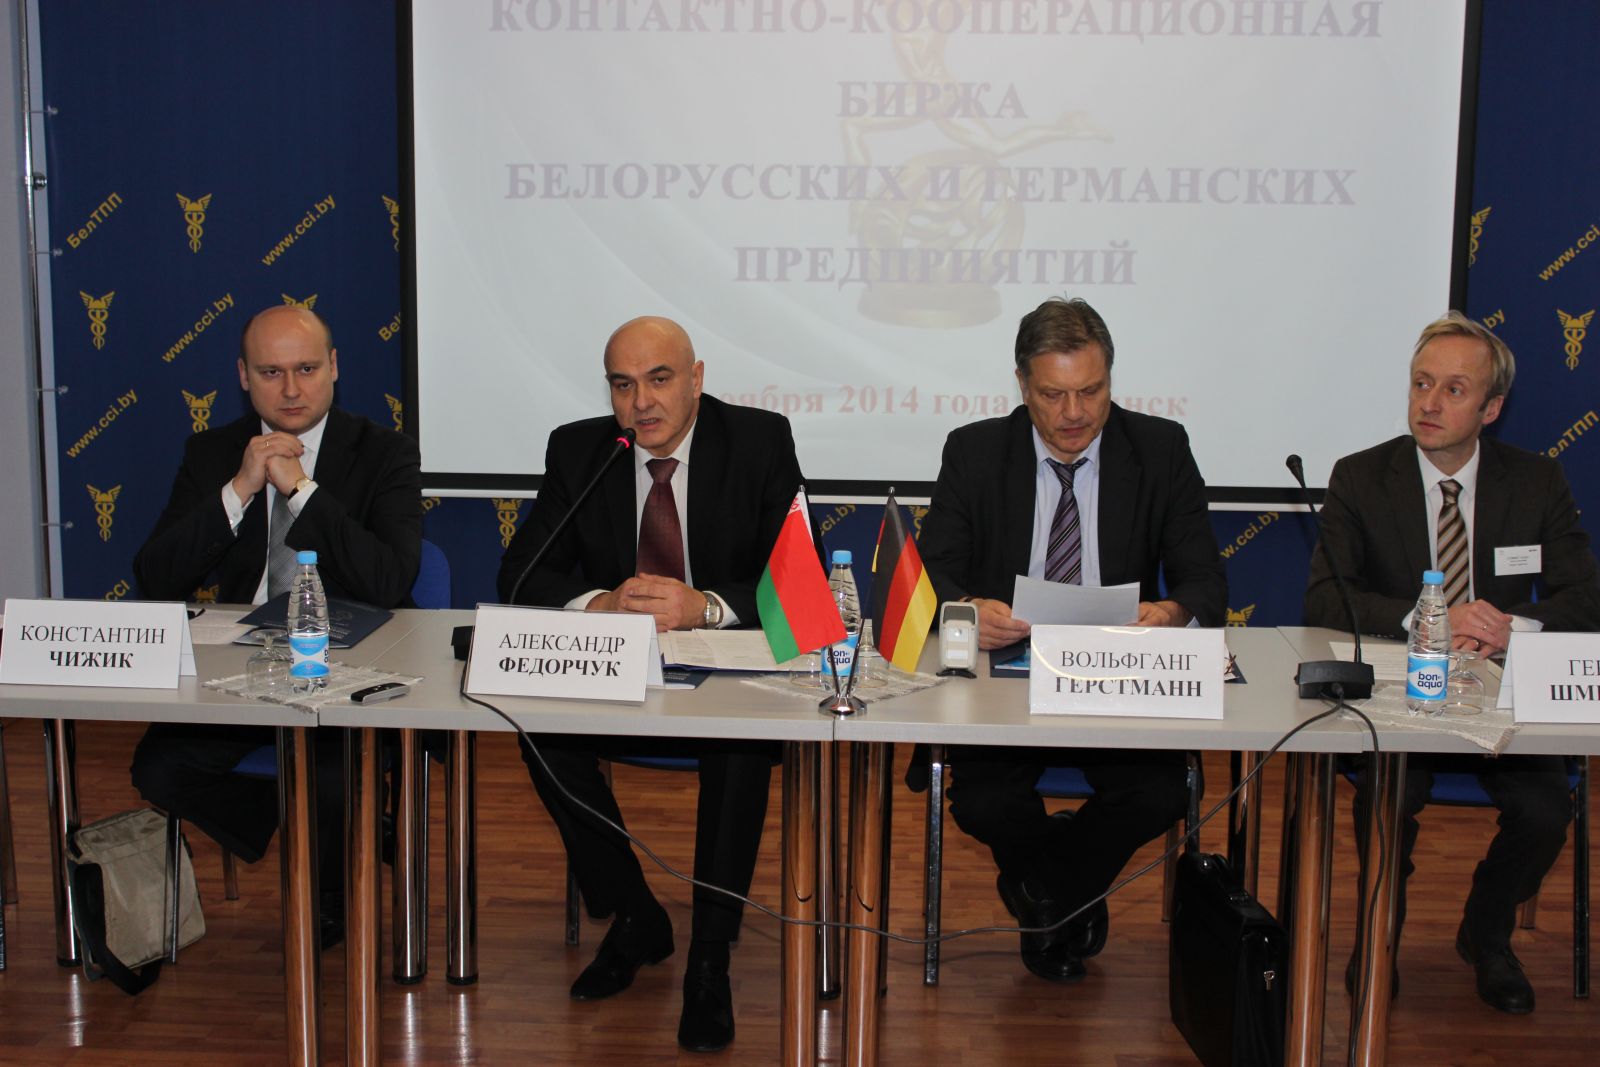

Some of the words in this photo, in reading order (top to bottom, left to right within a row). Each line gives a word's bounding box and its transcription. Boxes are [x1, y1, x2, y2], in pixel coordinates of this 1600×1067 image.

[489, 0, 1383, 43] КОНТАКТНО-КООПЕРАЦИОННАЯ
[836, 81, 1028, 119] БИРЖА
[505, 163, 909, 201] БЕЛОРУССКИХ
[929, 165, 965, 200] И
[984, 166, 1358, 205] ГЕРМАНСКИХ
[67, 192, 122, 248] БелТПП
[262, 194, 336, 266] www.cci.by
[733, 240, 1138, 291] ПРЕДПРИЯТИЙ
[162, 293, 235, 363] www.cci.by
[719, 384, 824, 417] оября
[838, 384, 919, 415] 2014
[933, 394, 1009, 417] года
[67, 389, 138, 459] www.cci.by
[1539, 411, 1599, 458] елТПП
[21, 625, 165, 644] КОНСТАНТИН
[499, 633, 625, 656] АЛЕКСАНДР
[50, 650, 134, 669] ЧИЖИК
[498, 656, 621, 678] ФЕДОРЧУК
[1061, 650, 1199, 671] ВОЛЬФГАНГ
[1055, 676, 1203, 697] ГЕРСТМАНН
[1417, 680, 1443, 690] aqua
